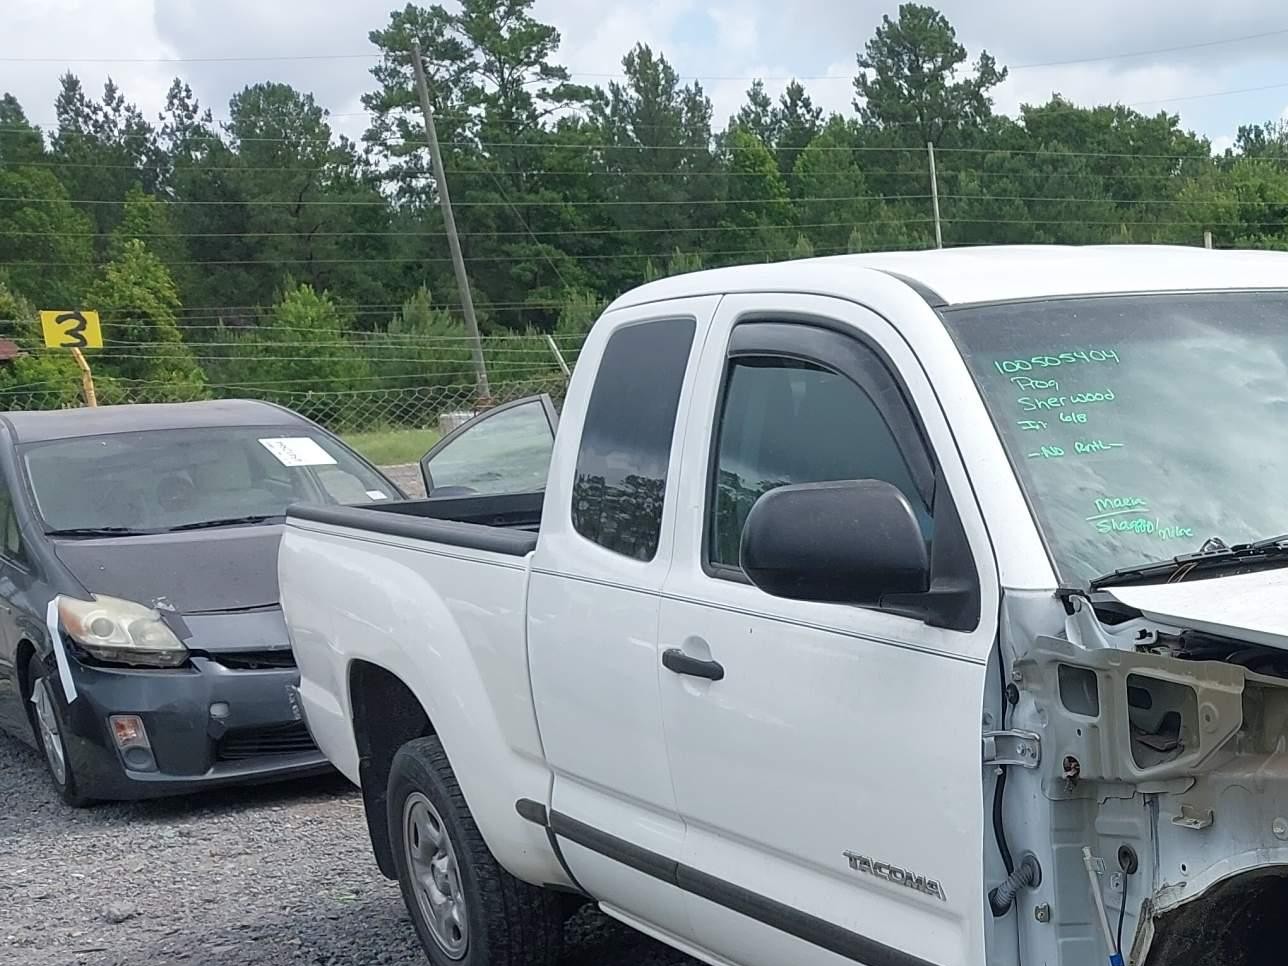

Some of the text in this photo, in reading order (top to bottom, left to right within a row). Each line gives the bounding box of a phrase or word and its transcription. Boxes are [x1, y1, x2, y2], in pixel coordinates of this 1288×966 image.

[55, 312, 88, 347] 3
[994, 350, 1120, 374] 100505404
[1017, 389, 1115, 411] Sherwood
[842, 850, 948, 902] TACOMA
